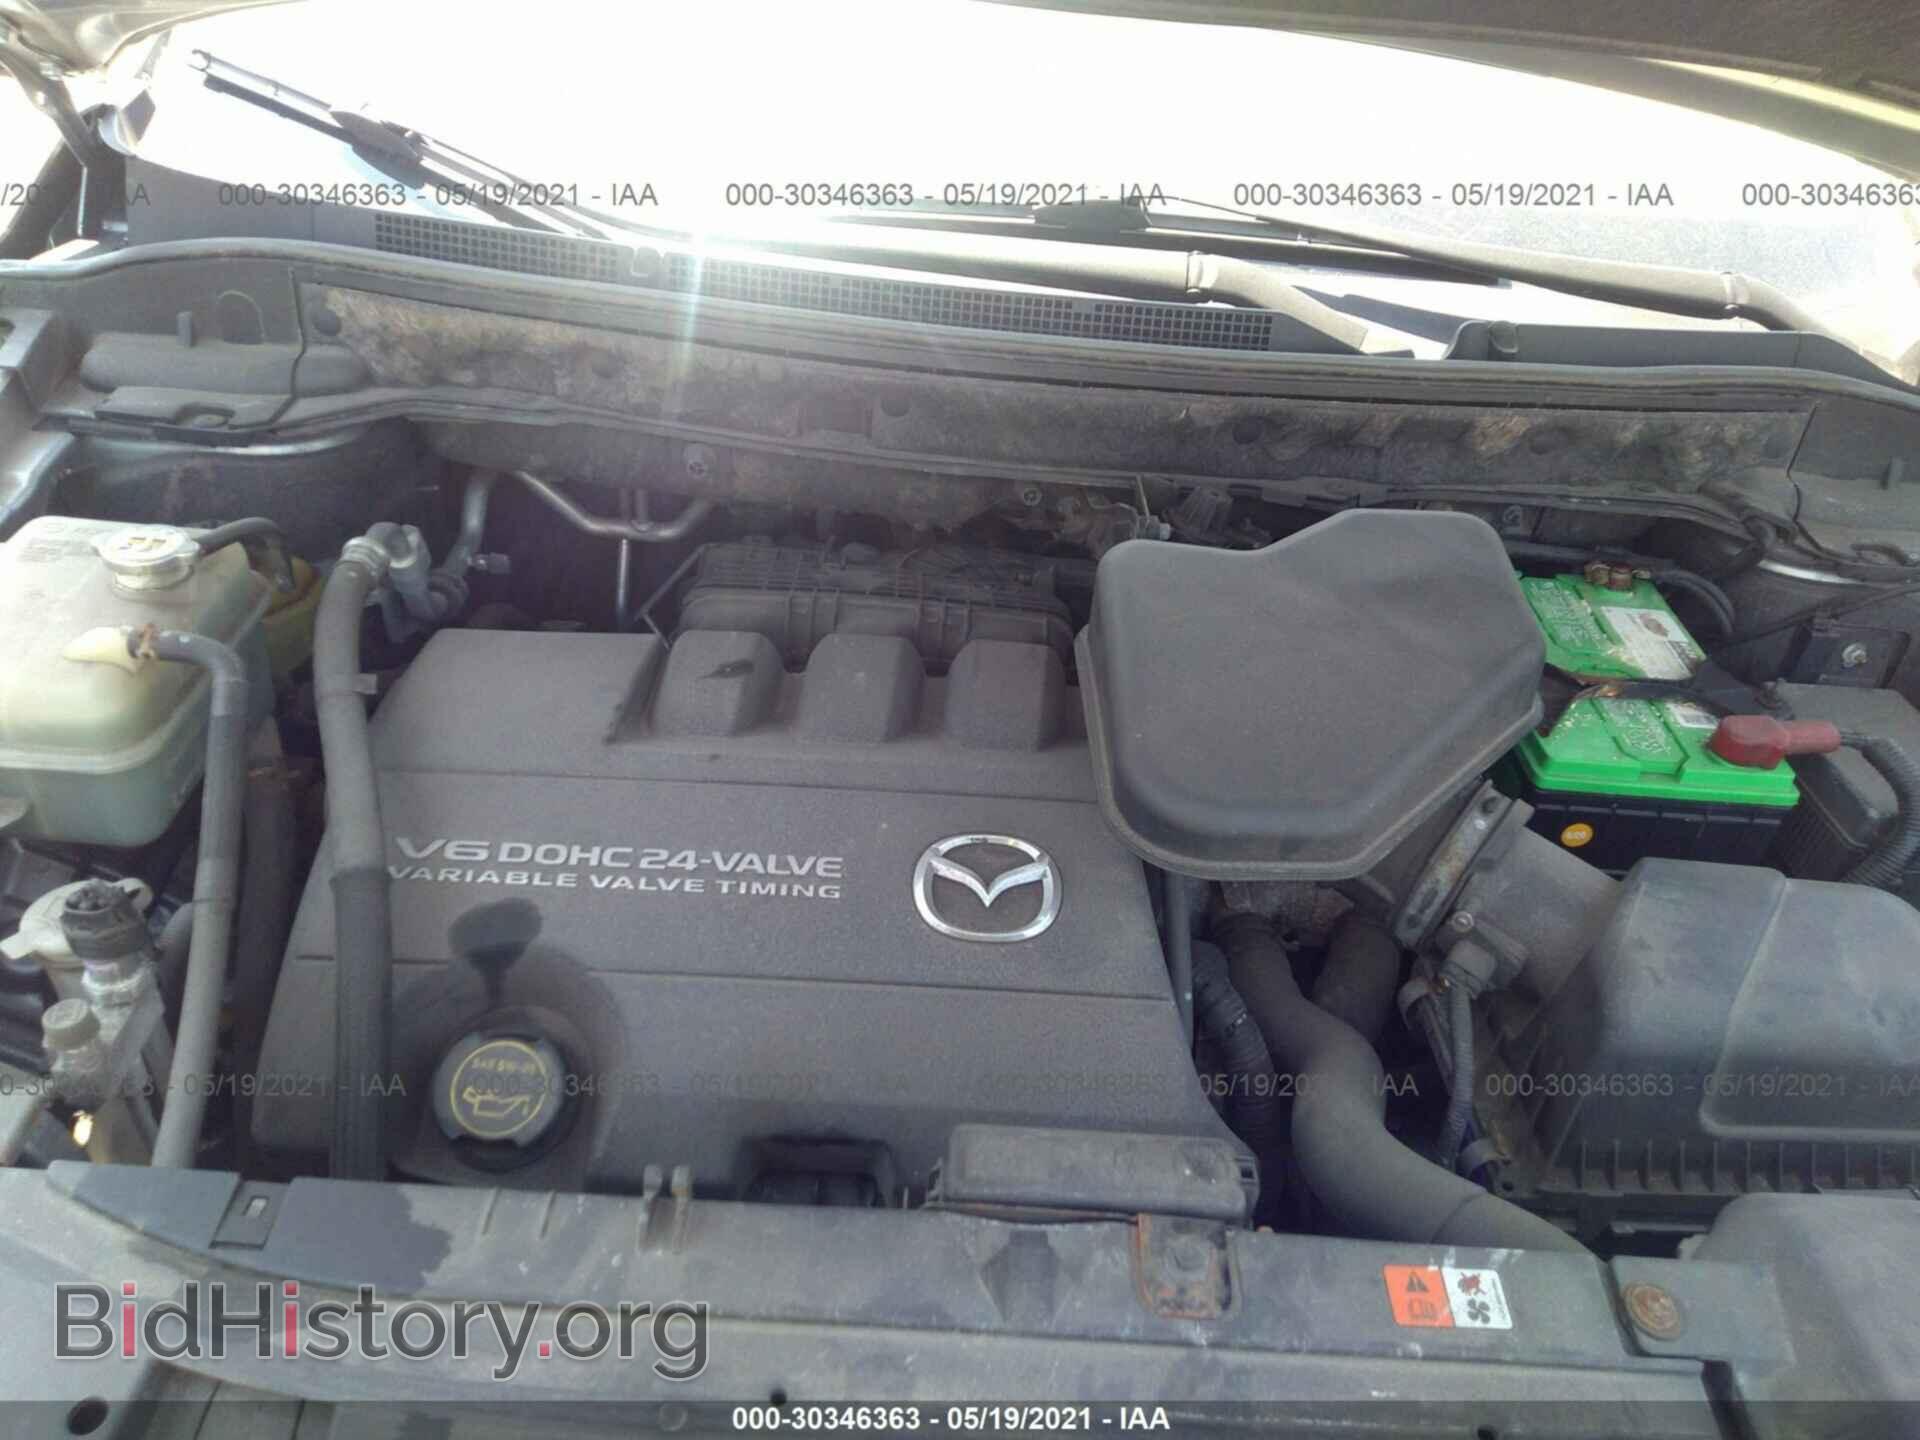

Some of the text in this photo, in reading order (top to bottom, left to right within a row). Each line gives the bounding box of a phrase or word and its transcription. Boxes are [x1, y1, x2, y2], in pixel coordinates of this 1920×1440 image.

[395, 837, 845, 878] V6 DOHC 24-VALVE
[386, 864, 842, 899] VARIABLE VALVE TIMING
